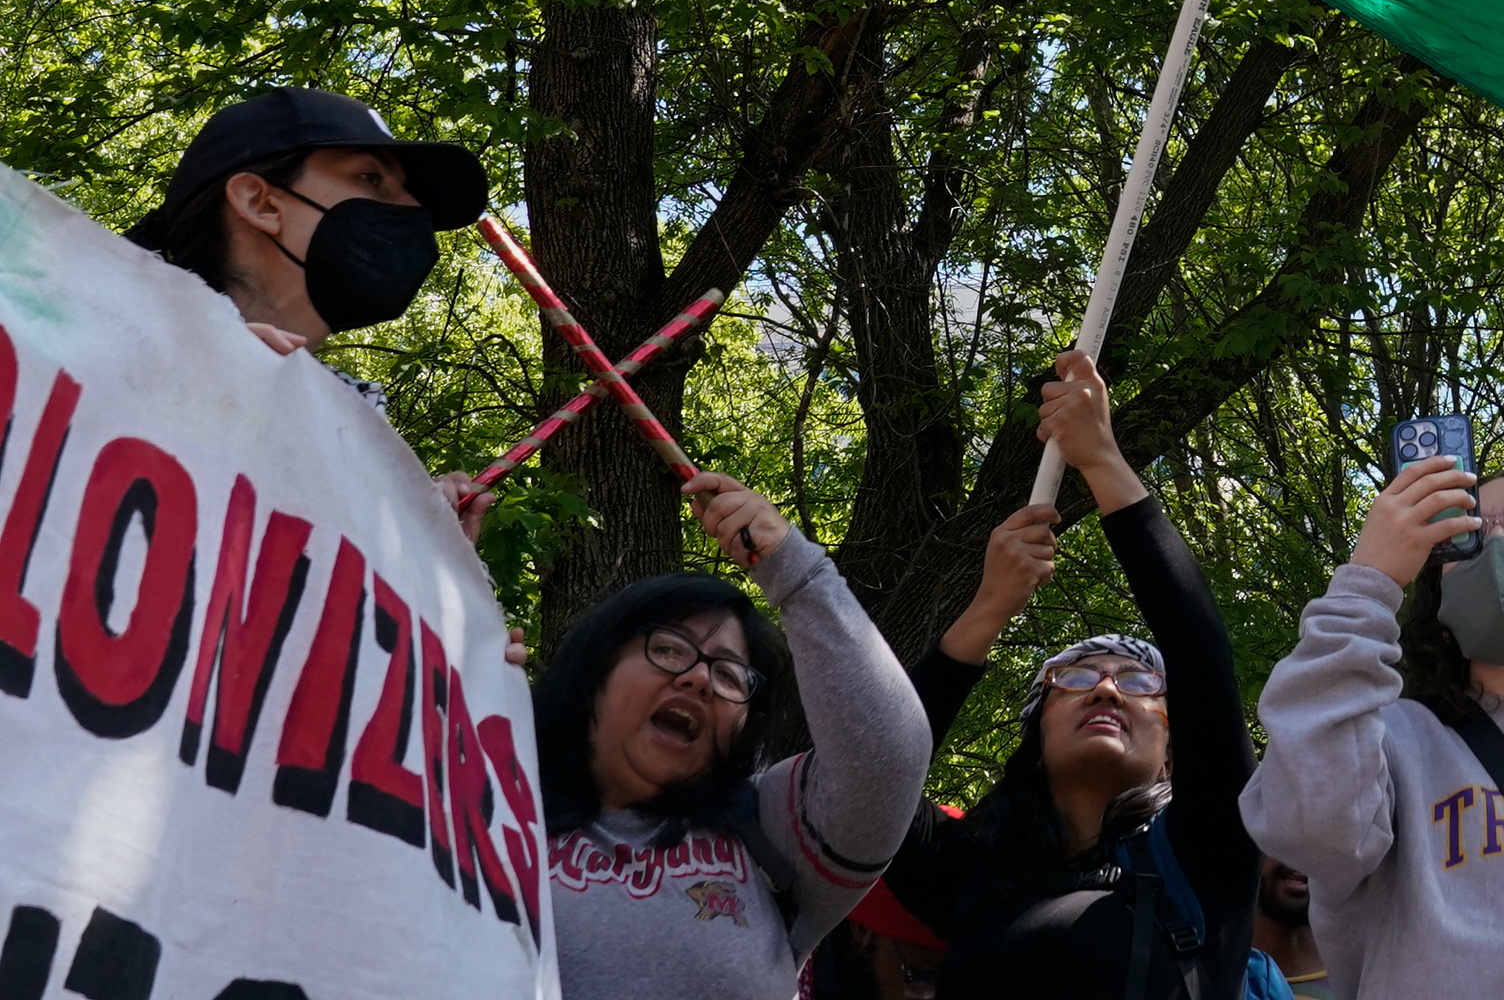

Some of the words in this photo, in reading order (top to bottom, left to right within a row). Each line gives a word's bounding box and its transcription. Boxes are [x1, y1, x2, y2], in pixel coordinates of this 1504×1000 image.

[1182, 16, 1202, 57] EAGLE
[1157, 110, 1171, 135] 3/4"
[1146, 138, 1162, 169] SCH40
[1141, 169, 1153, 188] PVC
[1133, 190, 1146, 212] 1120
[1125, 213, 1139, 236] 480
[1116, 240, 1130, 263] PSI
[1096, 305, 1111, 330] ASTM
